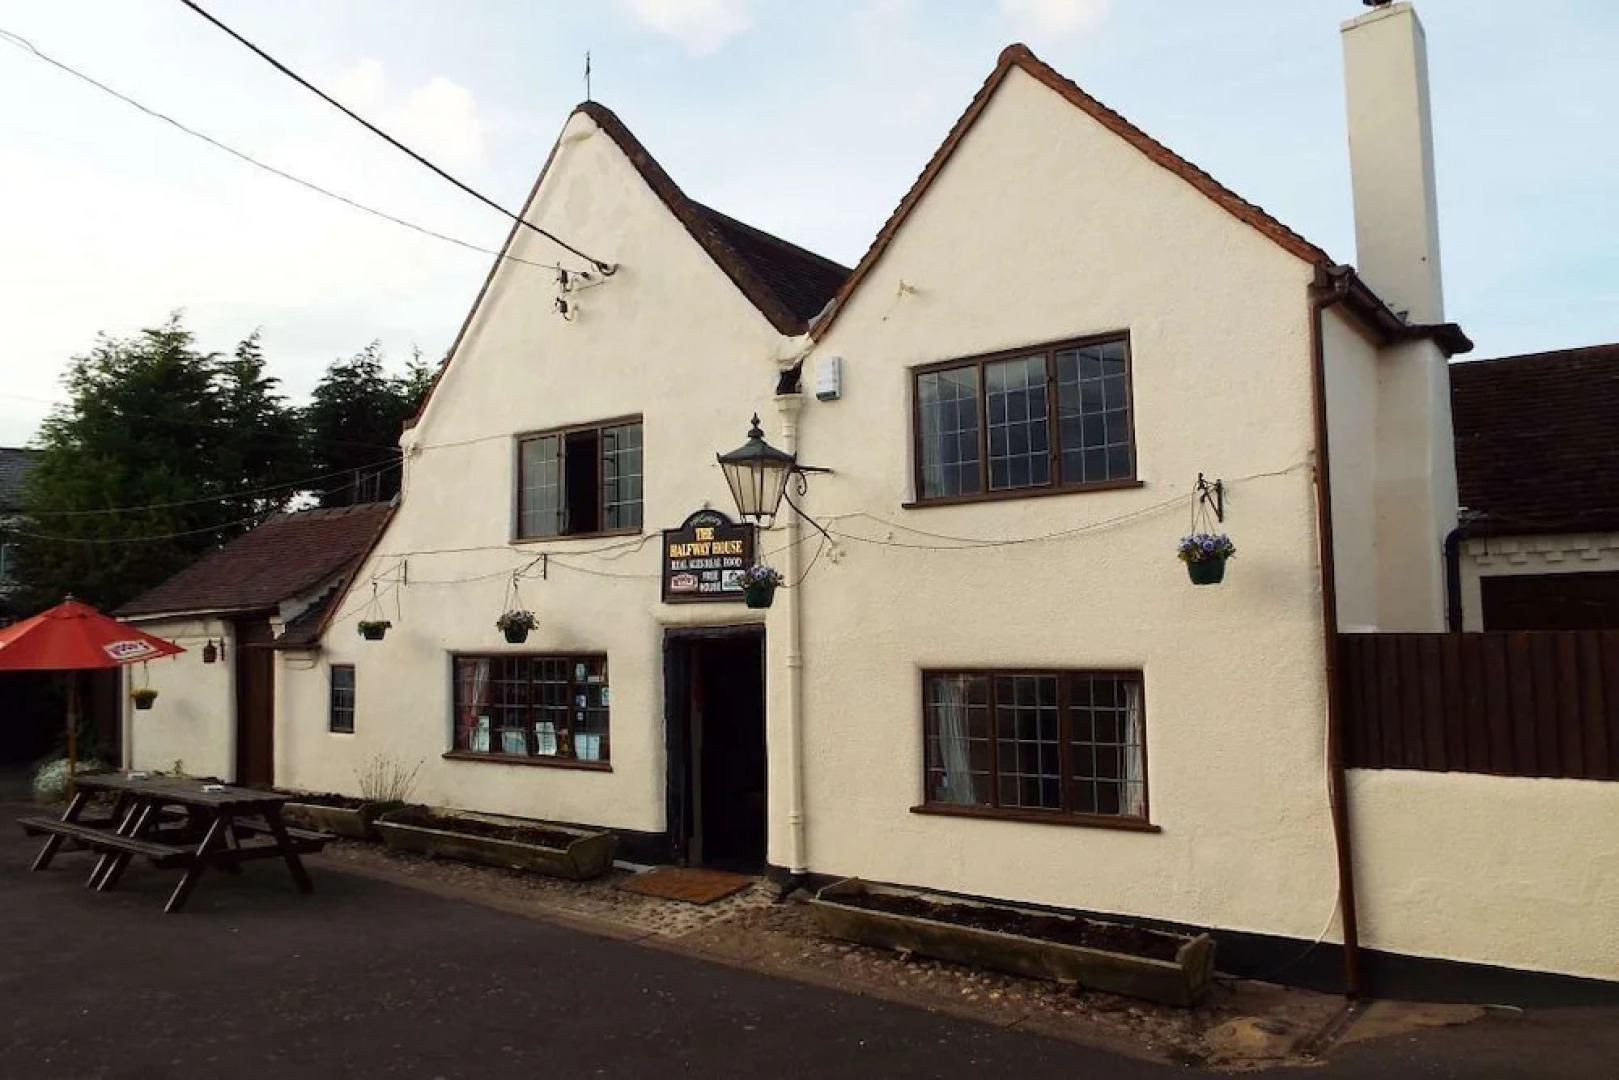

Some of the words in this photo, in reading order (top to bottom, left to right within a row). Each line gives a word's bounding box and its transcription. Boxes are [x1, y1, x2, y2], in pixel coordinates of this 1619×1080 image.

[695, 527, 715, 541] THE
[669, 542, 711, 558] HALFWAY
[712, 540, 743, 555] HOUSE
[724, 556, 743, 568] FOOD
